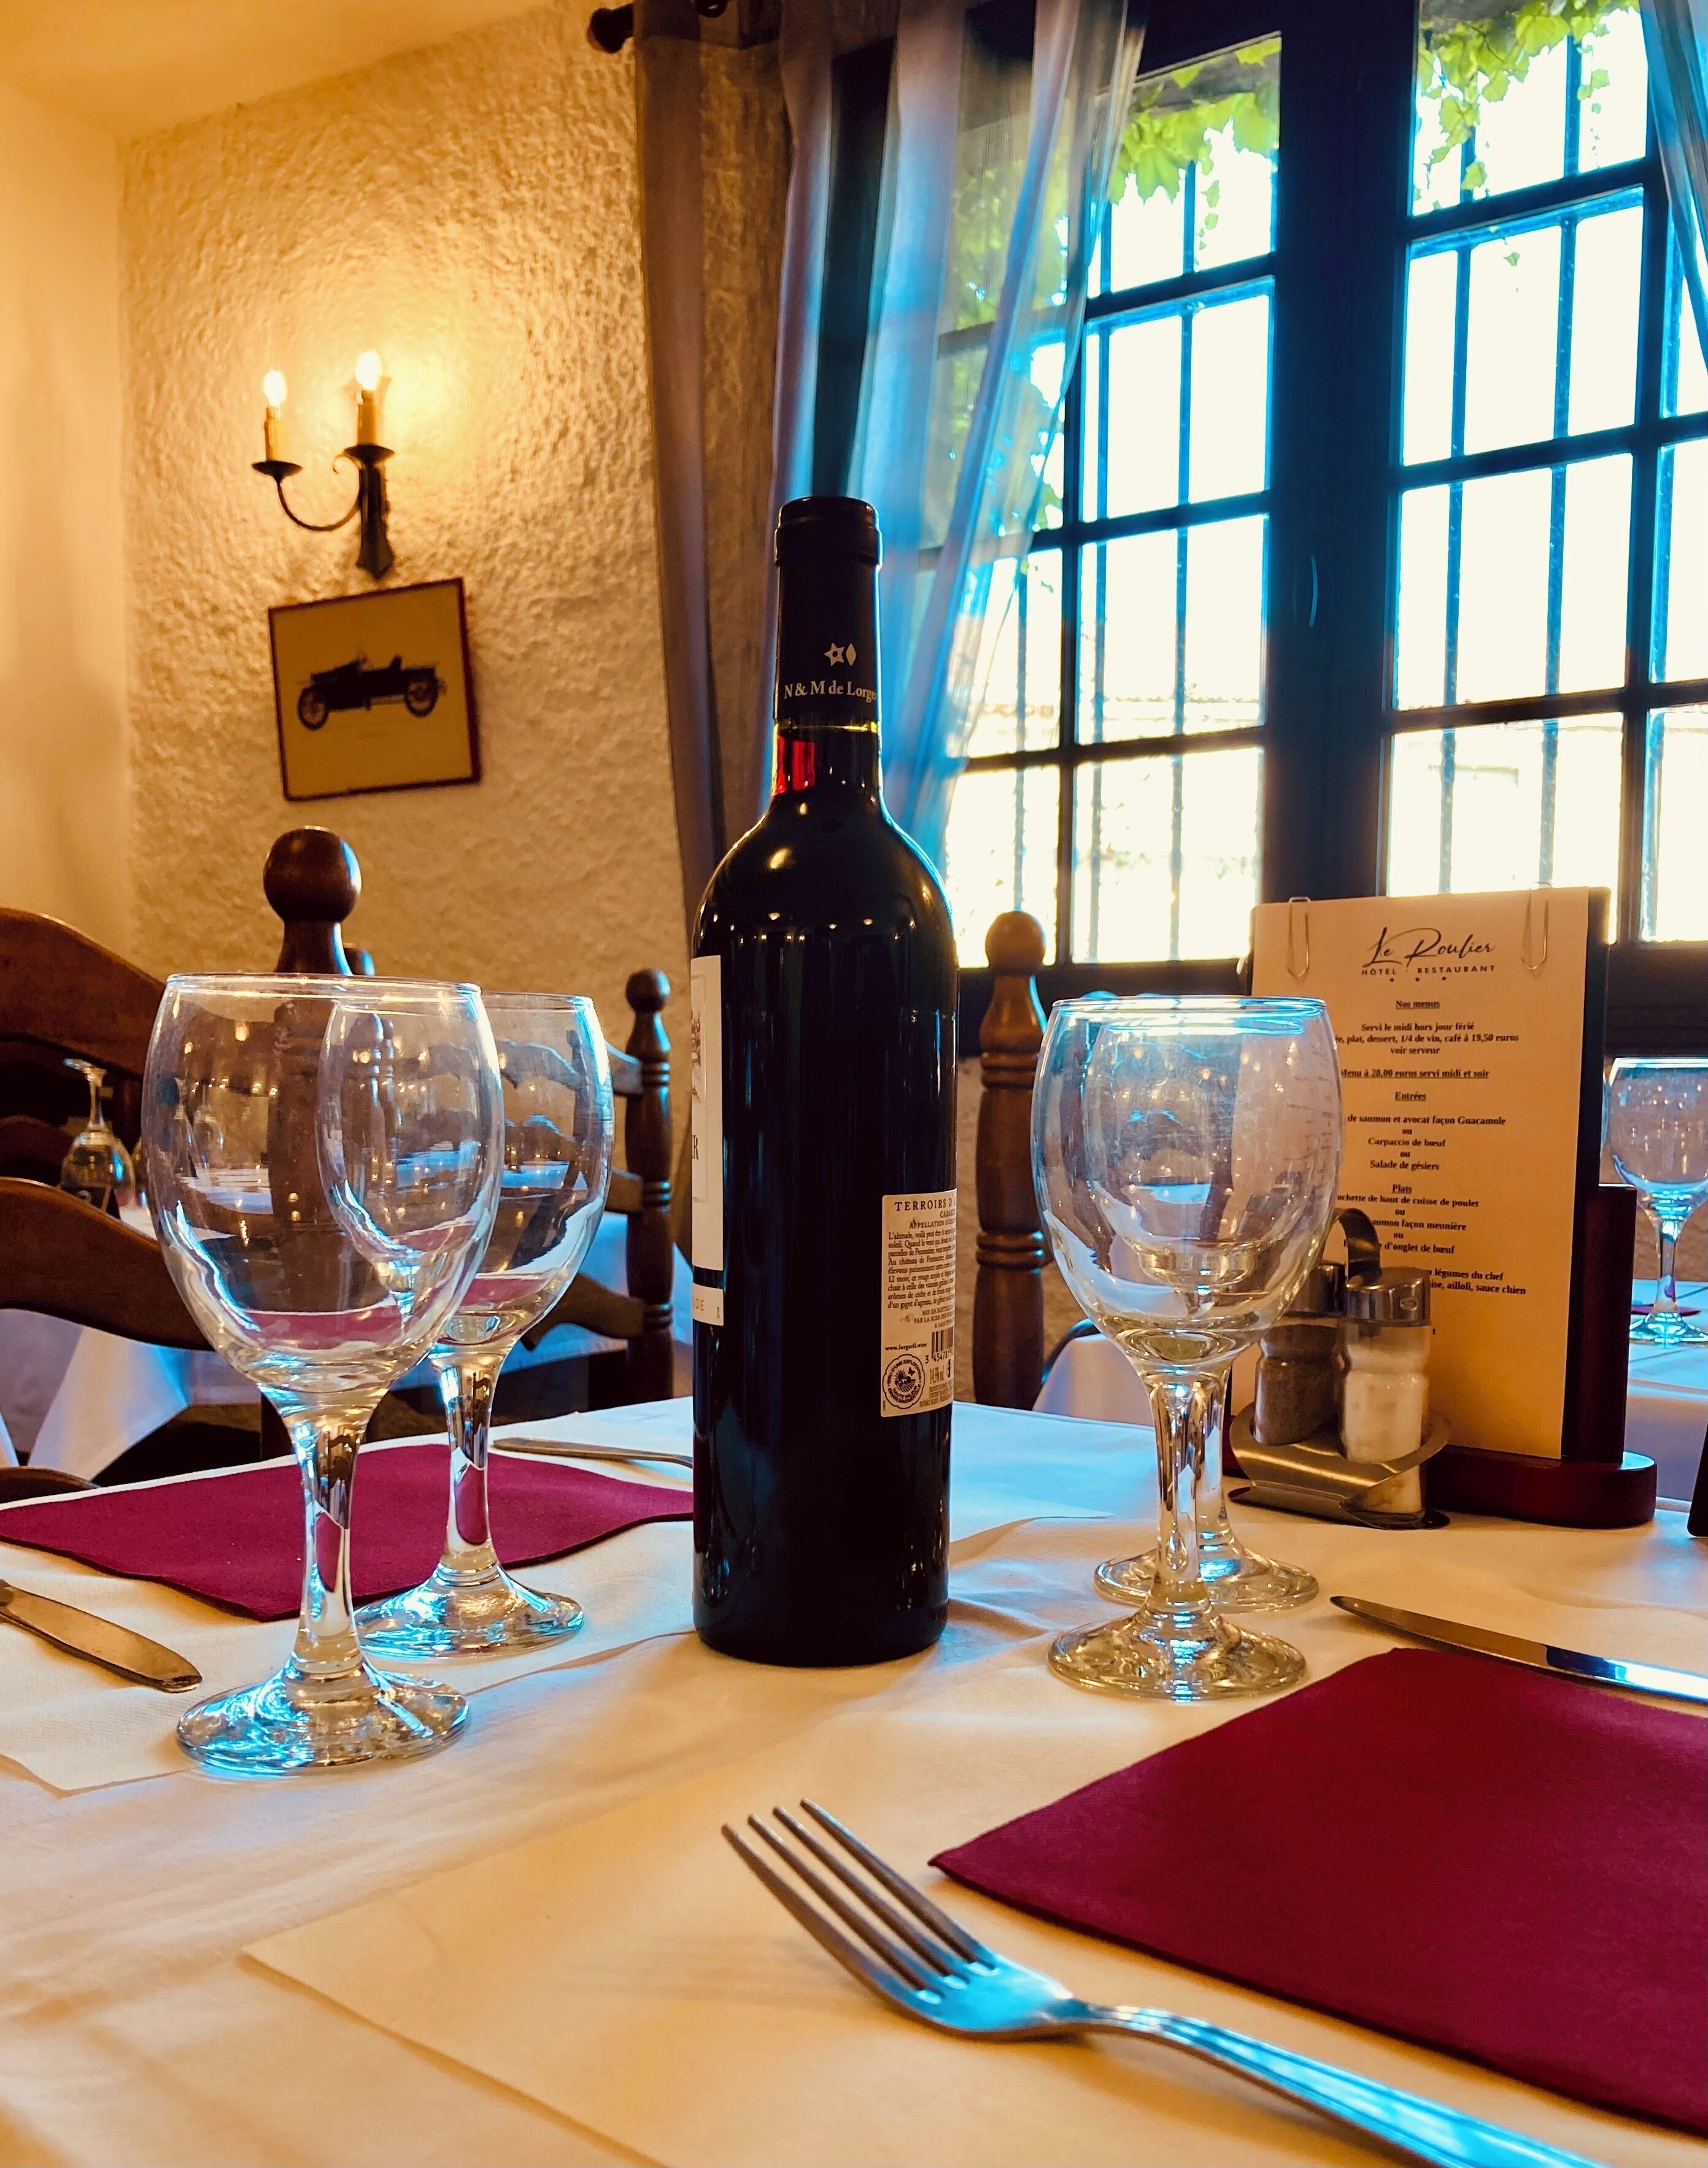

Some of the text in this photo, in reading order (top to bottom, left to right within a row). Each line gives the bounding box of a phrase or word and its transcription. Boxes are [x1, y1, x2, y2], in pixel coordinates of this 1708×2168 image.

[829, 680, 844, 694] de
[1362, 927, 1496, 968] Le Roulier
[1361, 965, 1496, 976] HÔTEL RESTAURANT
[1396, 1000, 1440, 1009] Nos menus
[1361, 1023, 1381, 1032] Servi
[1384, 1023, 1392, 1032] le
[1414, 1023, 1432, 1032] hors
[1434, 1023, 1453, 1032] jour
[1455, 1022, 1475, 1031] férié
[1347, 1035, 1364, 1044] plat,
[1367, 1035, 1398, 1044] dessert,
[1426, 1035, 1442, 1043] vin,
[1463, 1033, 1469, 1042] à
[1472, 1034, 1493, 1043] 19,50
[1364, 1069, 1369, 1078] à
[1419, 1069, 1440, 1078] servi
[1442, 1068, 1461, 1078] midi
[1473, 1069, 1490, 1078] soir
[1394, 1092, 1426, 1101] Entrées
[1432, 1115, 1455, 1126] façon
[1458, 1116, 1506, 1125] Guacamole
[1367, 1137, 1445, 1148] Carpaccio de bœuf
[1370, 1160, 1440, 1171] Salade de gésiers
[1392, 1184, 1412, 1194] Plats
[895, 1198, 946, 1211] TERROIRS
[1380, 1195, 1398, 1203] haut
[1452, 1198, 1479, 1208] poulet
[1401, 1219, 1424, 1229] façon
[1426, 1221, 1467, 1231] meunière
[1384, 1242, 1418, 1253] d'onglet
[1420, 1244, 1431, 1252] de
[1432, 1245, 1455, 1254] bœuf
[1434, 1268, 1469, 1281] légumes
[1470, 1270, 1483, 1279] du
[1485, 1271, 1504, 1281] chef
[1475, 1284, 1500, 1293] sauce
[1502, 1284, 1526, 1295] chien
[925, 1355, 929, 1364] 3
